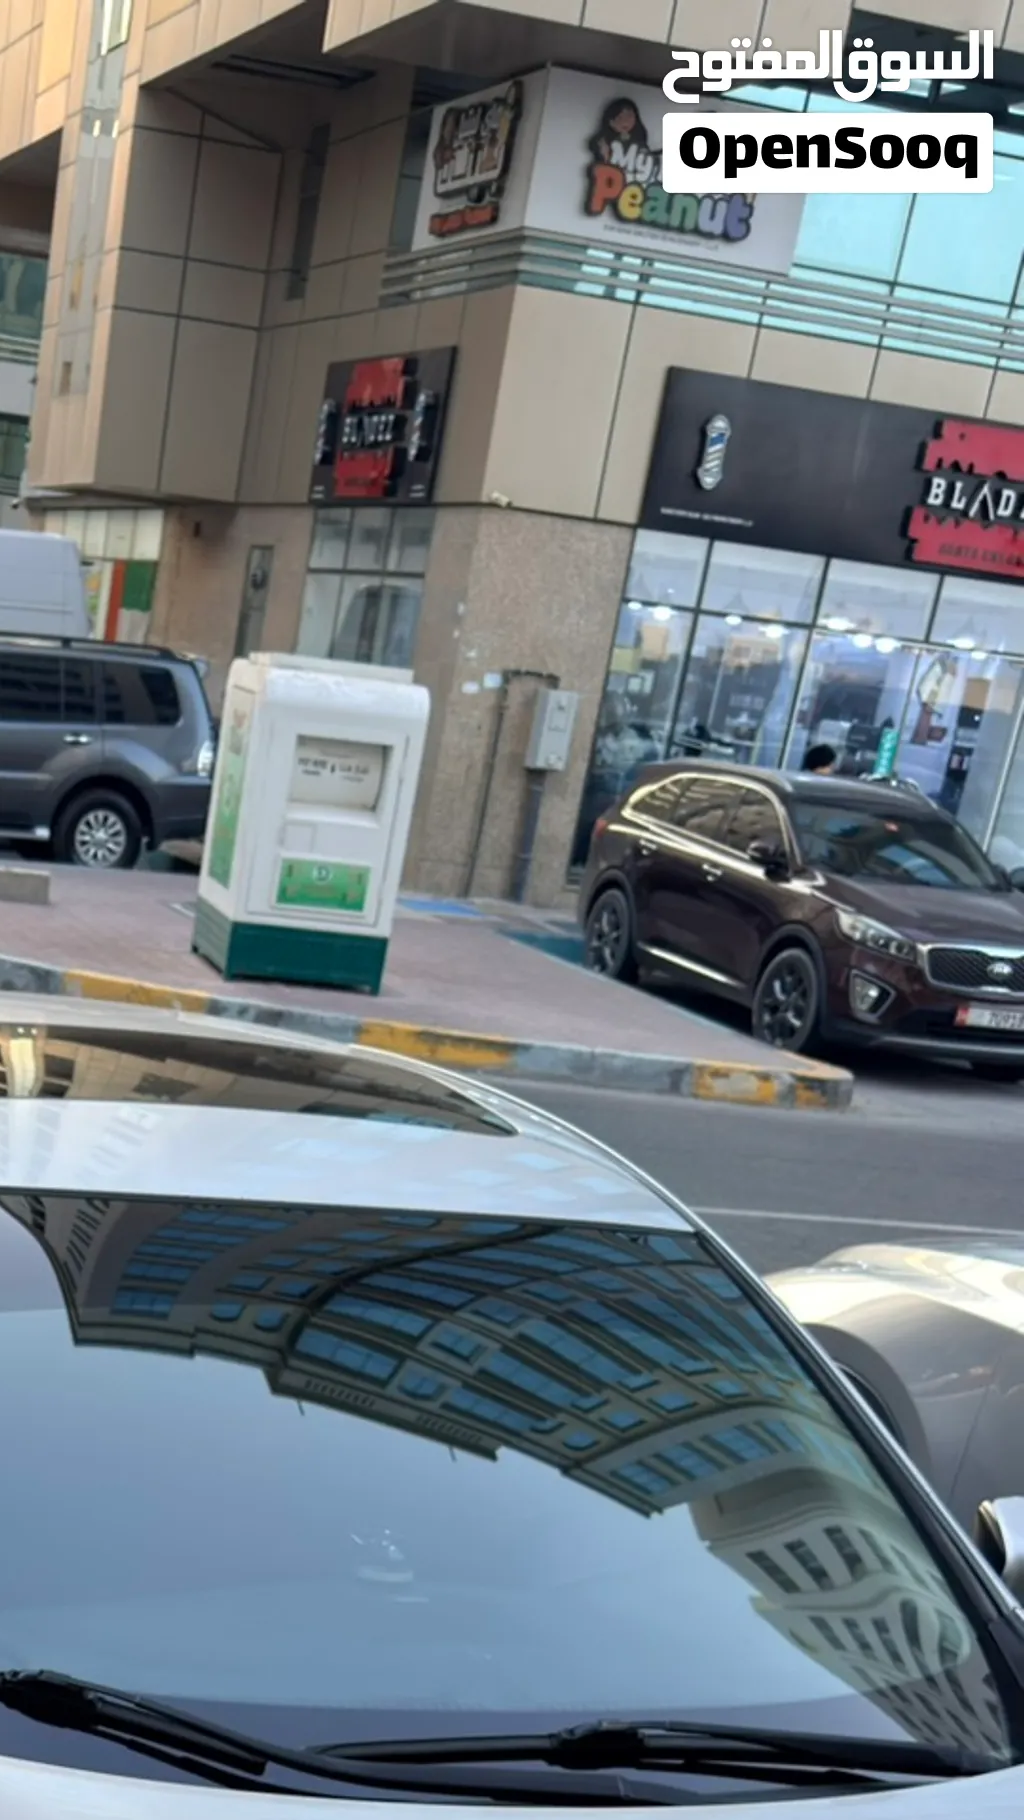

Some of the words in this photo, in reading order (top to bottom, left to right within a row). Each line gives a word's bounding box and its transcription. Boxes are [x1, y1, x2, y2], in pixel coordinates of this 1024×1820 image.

[609, 139, 655, 184] My
[589, 163, 753, 242] Peanut
[927, 476, 1024, 521] BLAD
